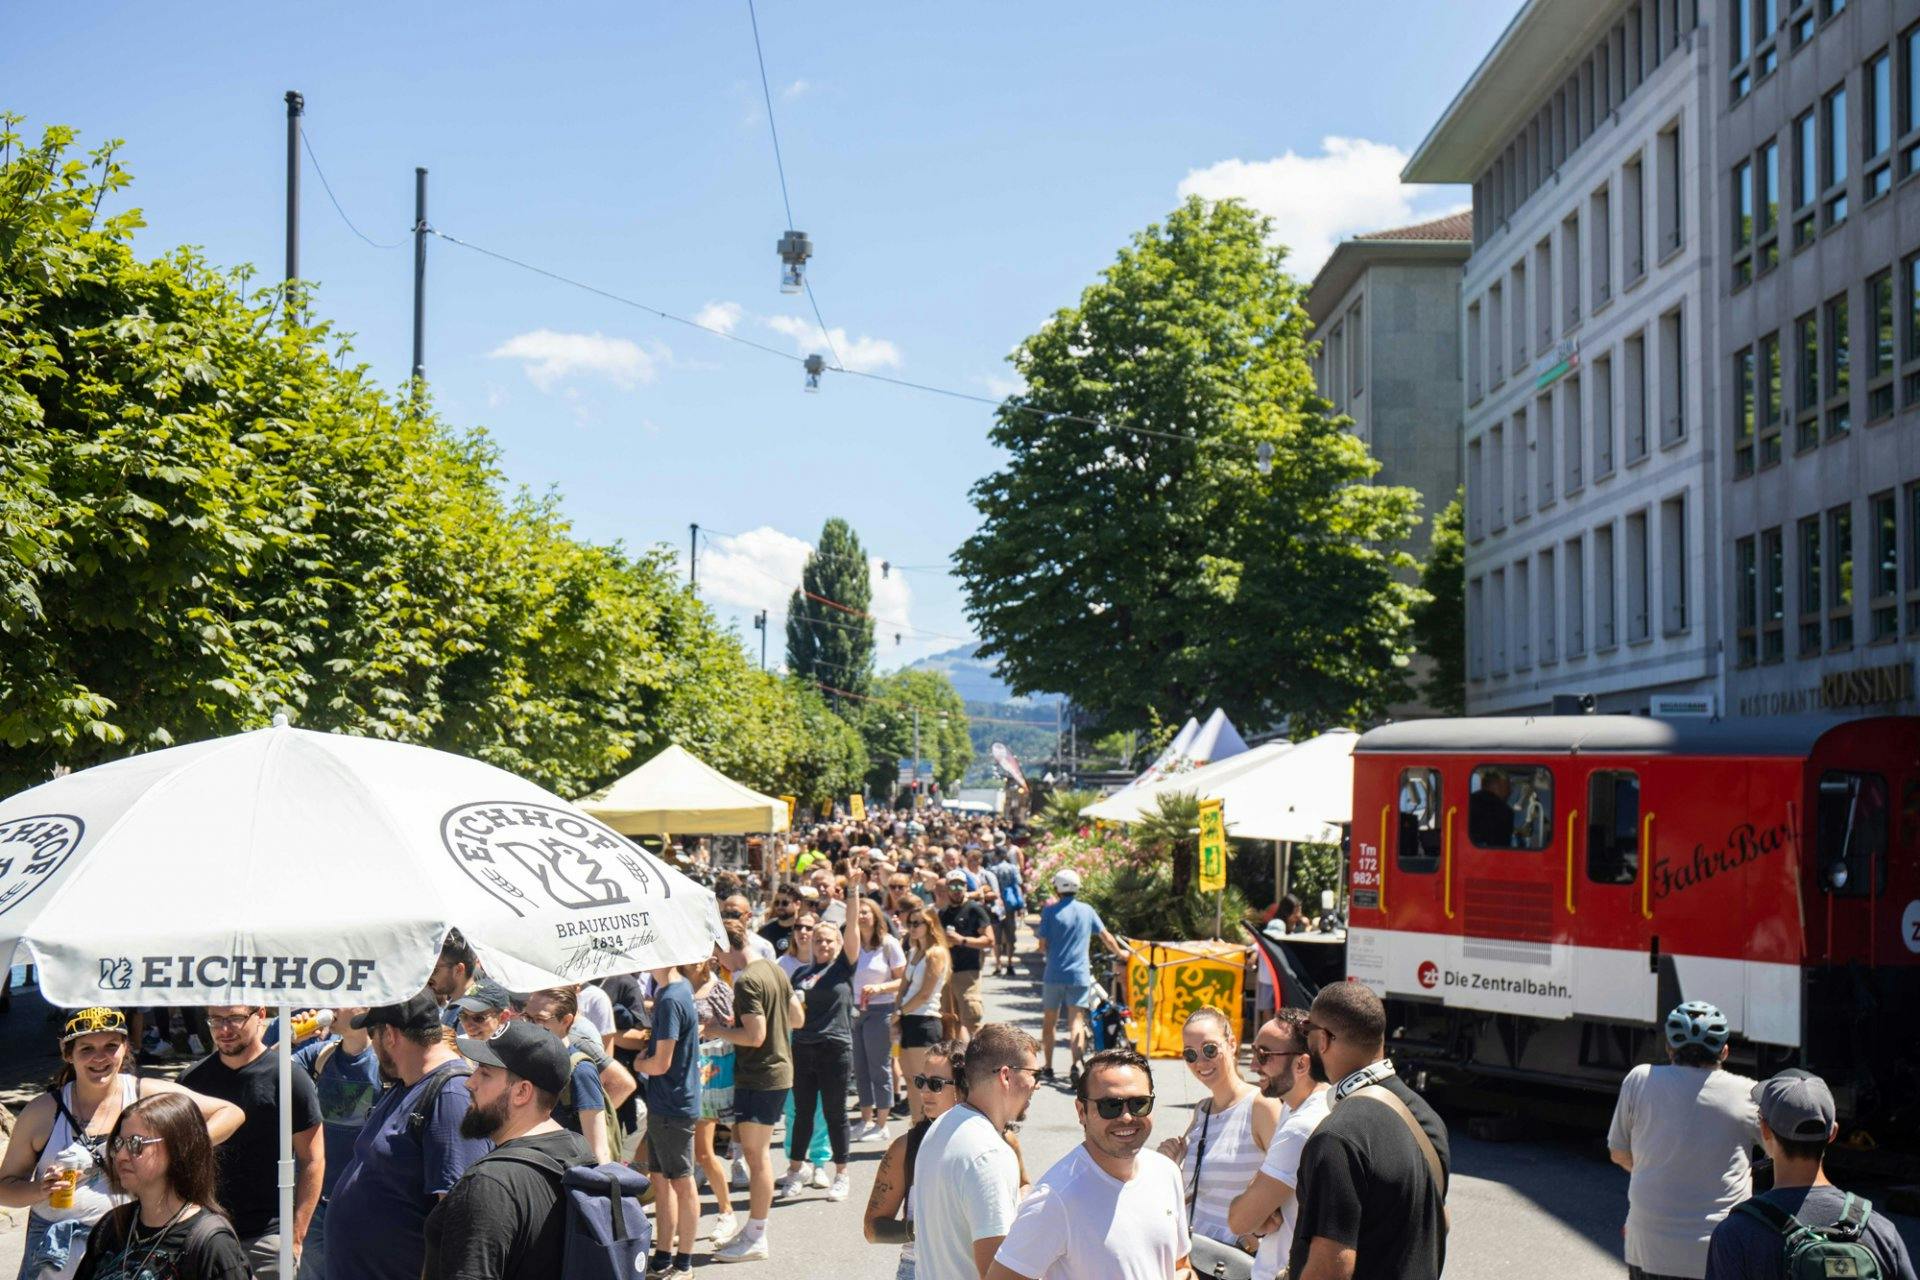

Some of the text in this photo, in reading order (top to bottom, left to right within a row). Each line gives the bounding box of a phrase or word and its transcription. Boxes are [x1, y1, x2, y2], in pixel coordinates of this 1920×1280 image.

[1822, 664, 1910, 706] ROSSINI
[0, 822, 69, 875] HHOF
[455, 808, 620, 864] EICHHOF
[1359, 843, 1377, 856] Tm
[1358, 858, 1378, 870] 172
[556, 911, 650, 938] BRAUKUNST
[592, 935, 624, 950] 1834
[141, 955, 376, 992] EICHHOF
[1444, 970, 1469, 988] Die
[1471, 973, 1573, 999] Zentralbahn.
[77, 1006, 113, 1018] TURBO
